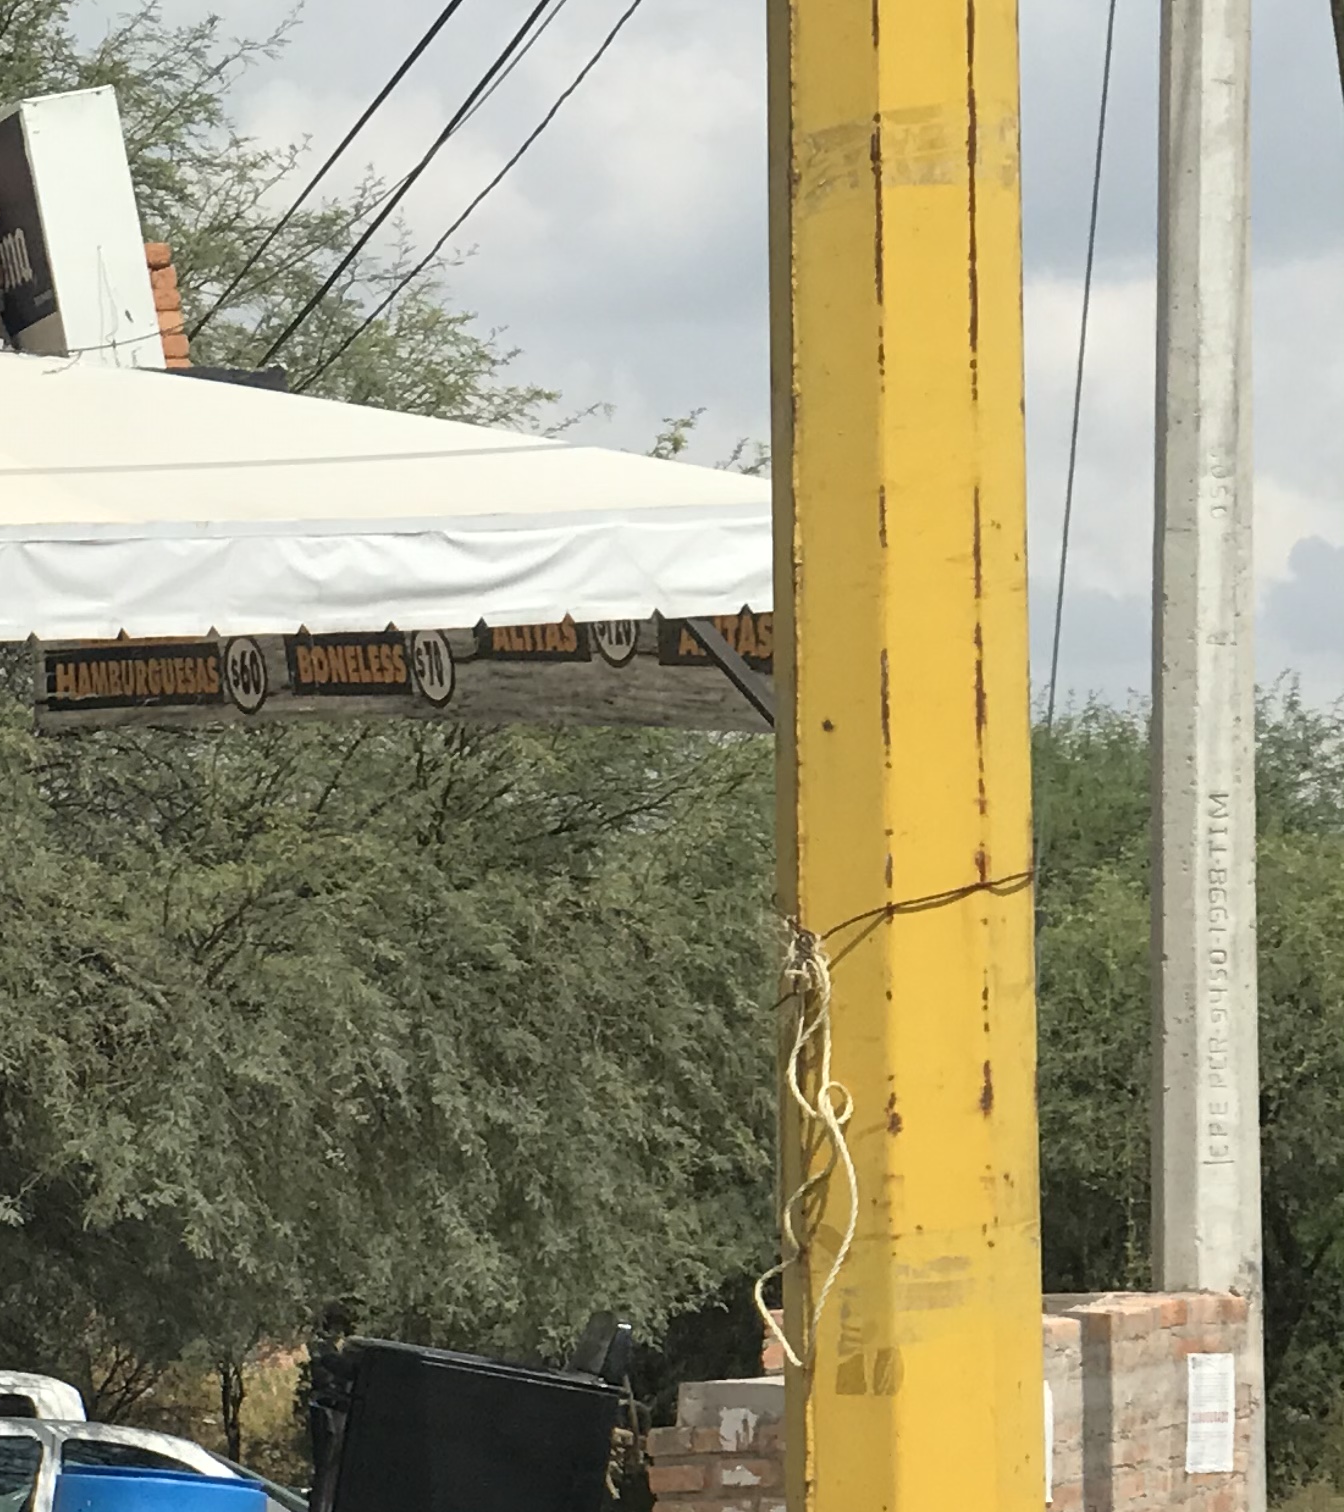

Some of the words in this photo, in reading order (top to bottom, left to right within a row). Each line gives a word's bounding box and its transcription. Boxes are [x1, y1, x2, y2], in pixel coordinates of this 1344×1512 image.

[55, 655, 220, 699] HAMBURGUESAS
[230, 649, 262, 696] $60
[295, 643, 408, 685] BONELESS
